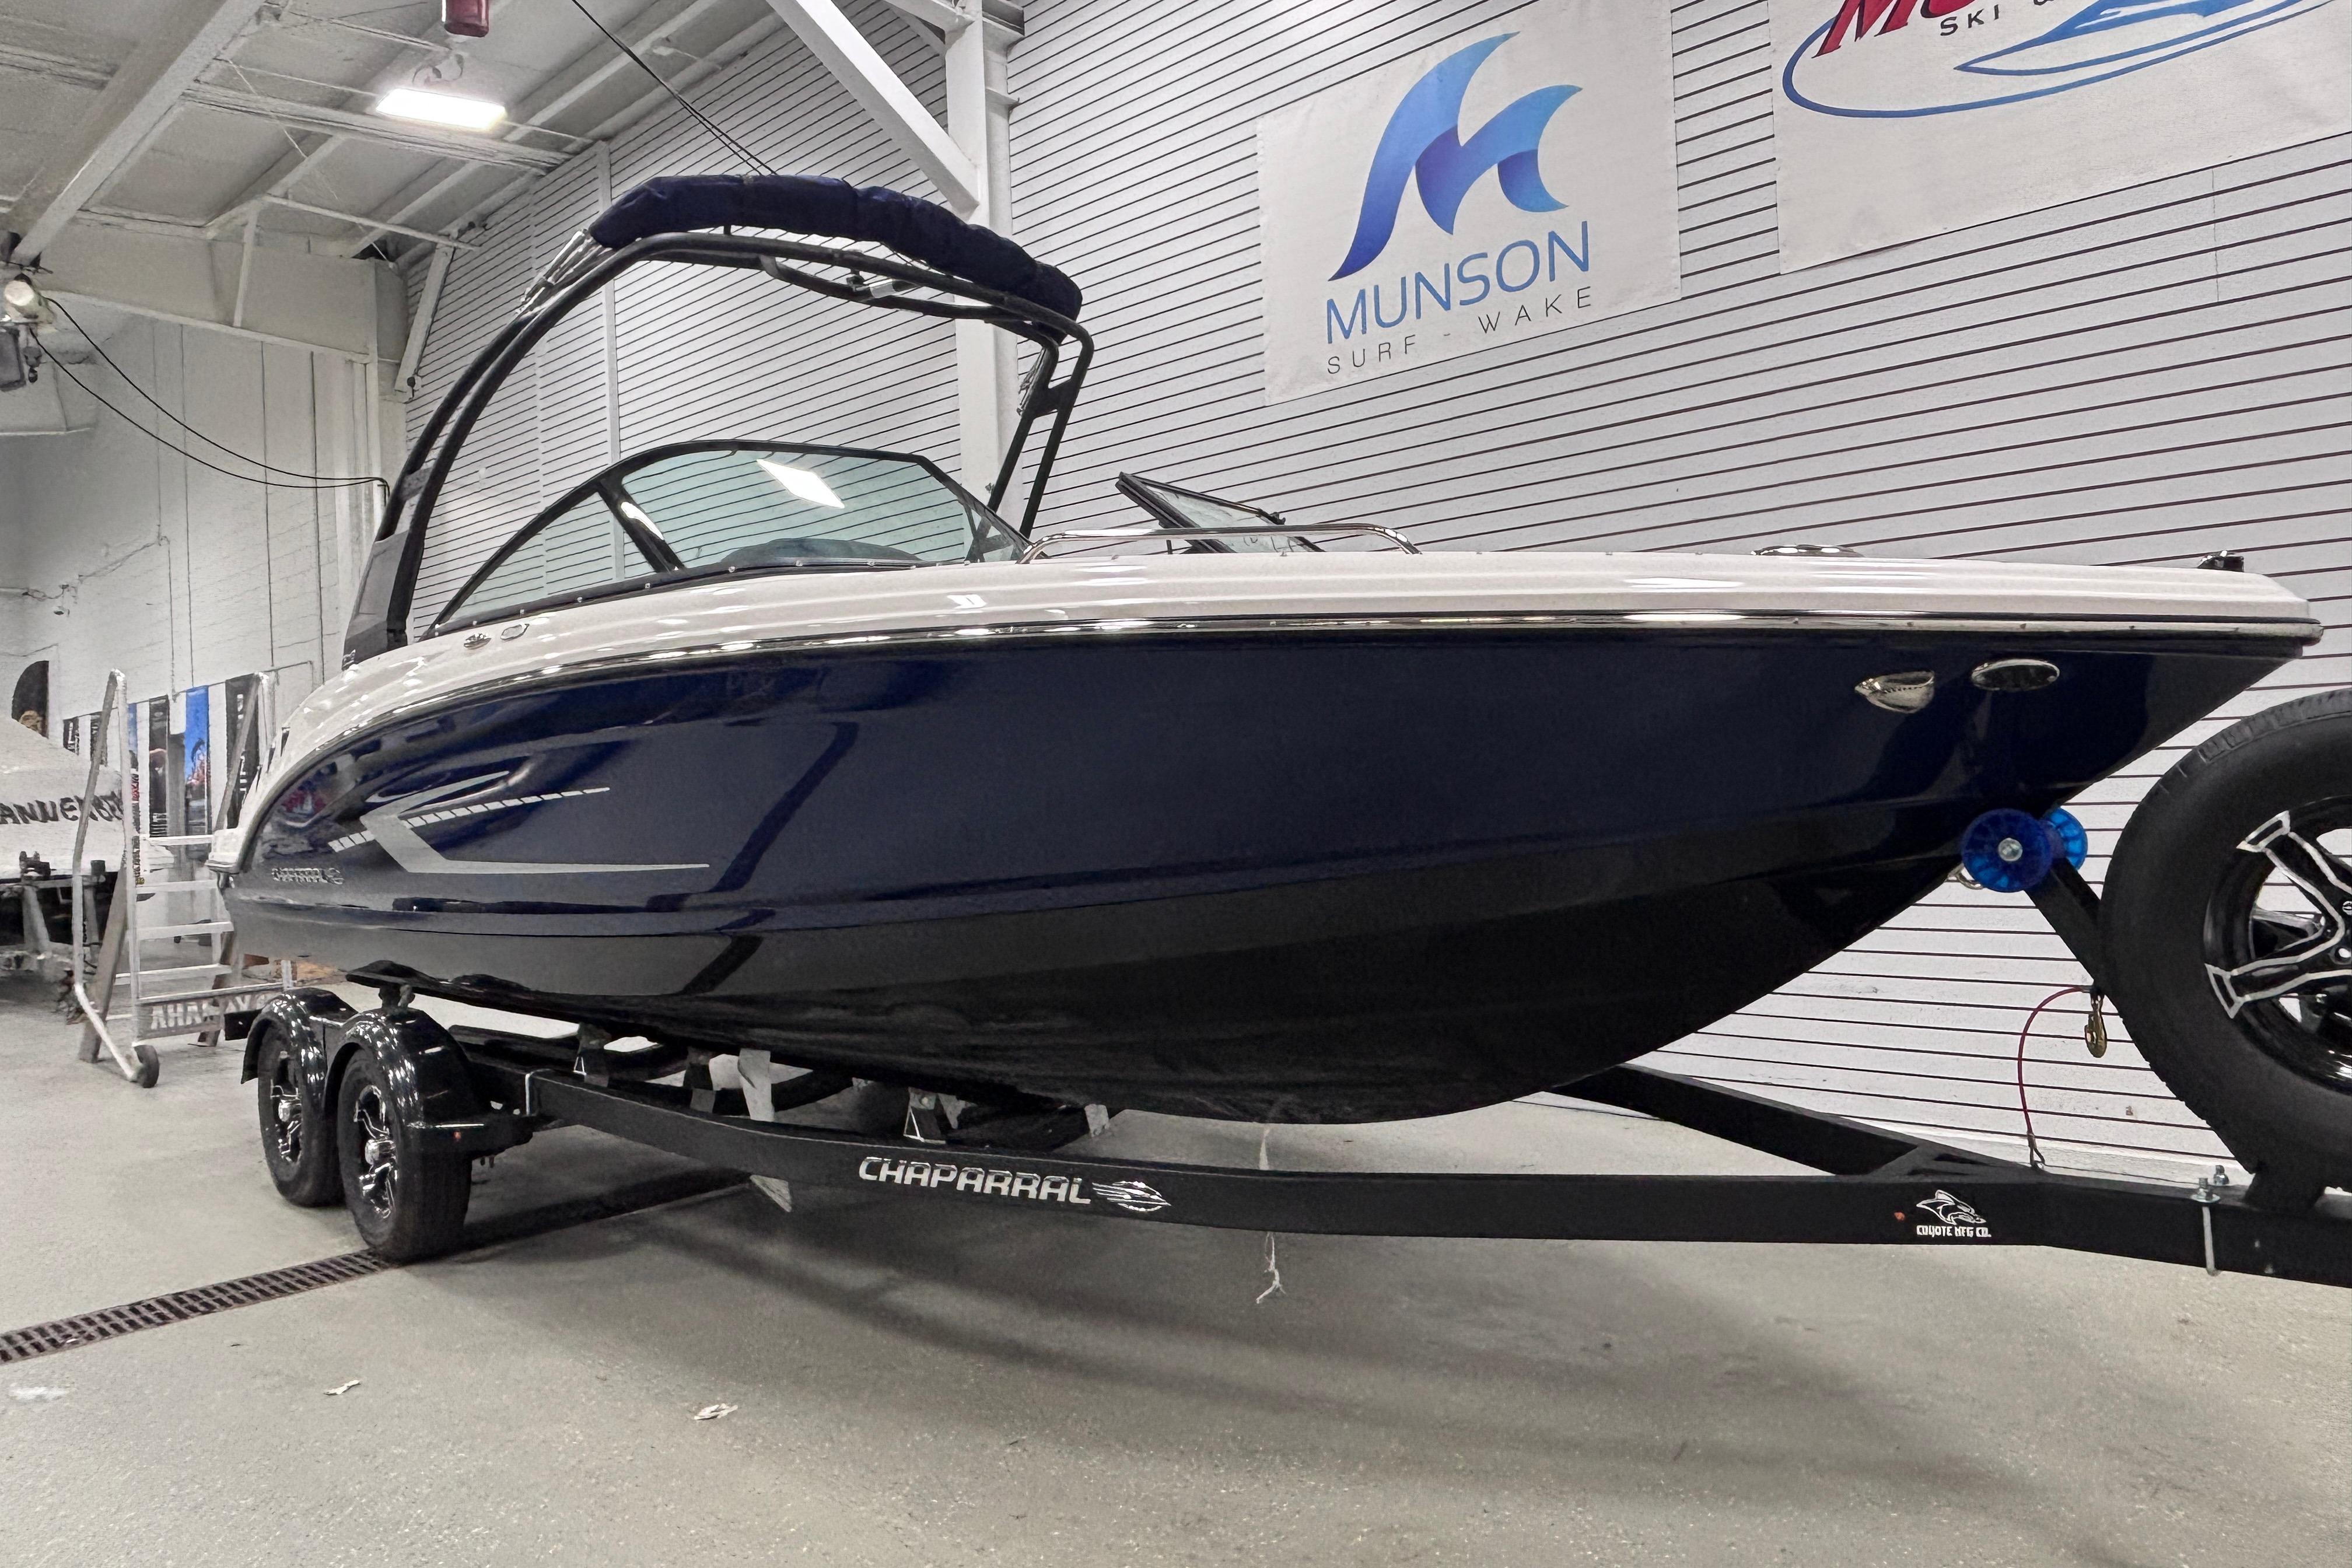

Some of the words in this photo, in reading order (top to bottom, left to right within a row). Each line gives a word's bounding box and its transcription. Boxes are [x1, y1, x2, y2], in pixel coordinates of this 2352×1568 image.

[1940, 4, 1999, 36] SKI
[1326, 220, 1590, 344] MUNSON
[1327, 335, 1416, 374] SURF
[1478, 286, 1591, 334] WAKE
[859, 1156, 1091, 1205] CHAPARRAL
[1916, 1224, 1952, 1237] COYOTE
[1954, 1226, 1975, 1237] MFG
